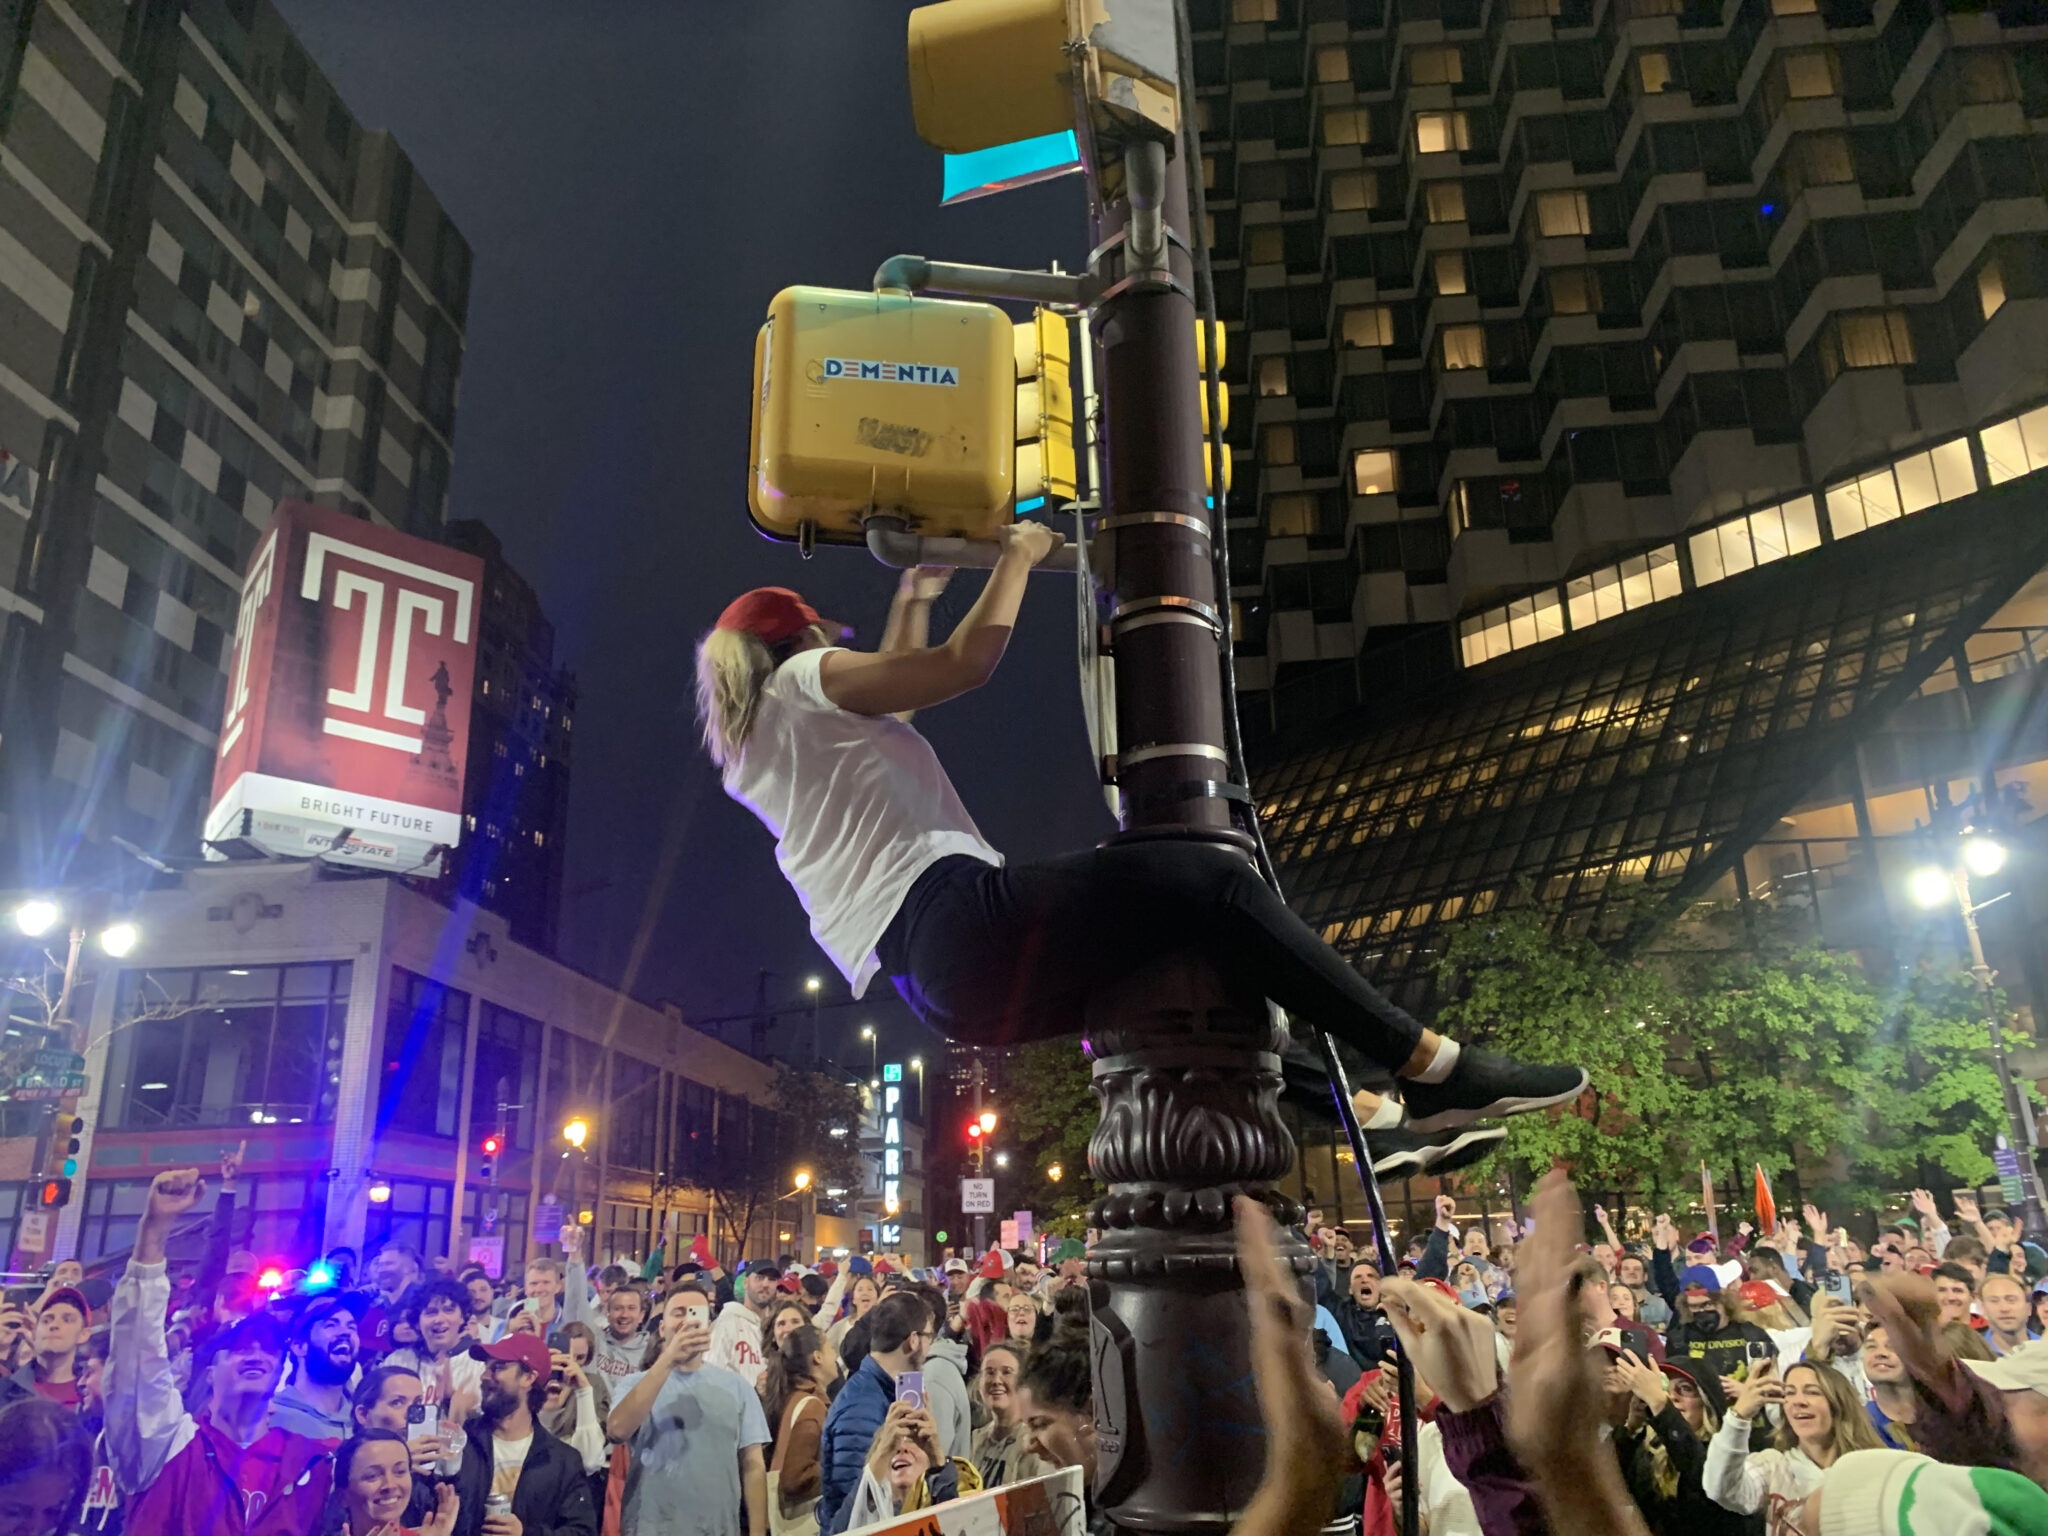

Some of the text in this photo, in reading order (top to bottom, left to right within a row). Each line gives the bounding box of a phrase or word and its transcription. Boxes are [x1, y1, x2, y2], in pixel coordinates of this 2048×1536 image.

[826, 359, 957, 385] DEMENTIA
[301, 796, 434, 833] BRIGHT FUTURE
[307, 833, 394, 858] INTRSTATE
[885, 1086, 900, 1213] PARK
[977, 1200, 991, 1208] RED
